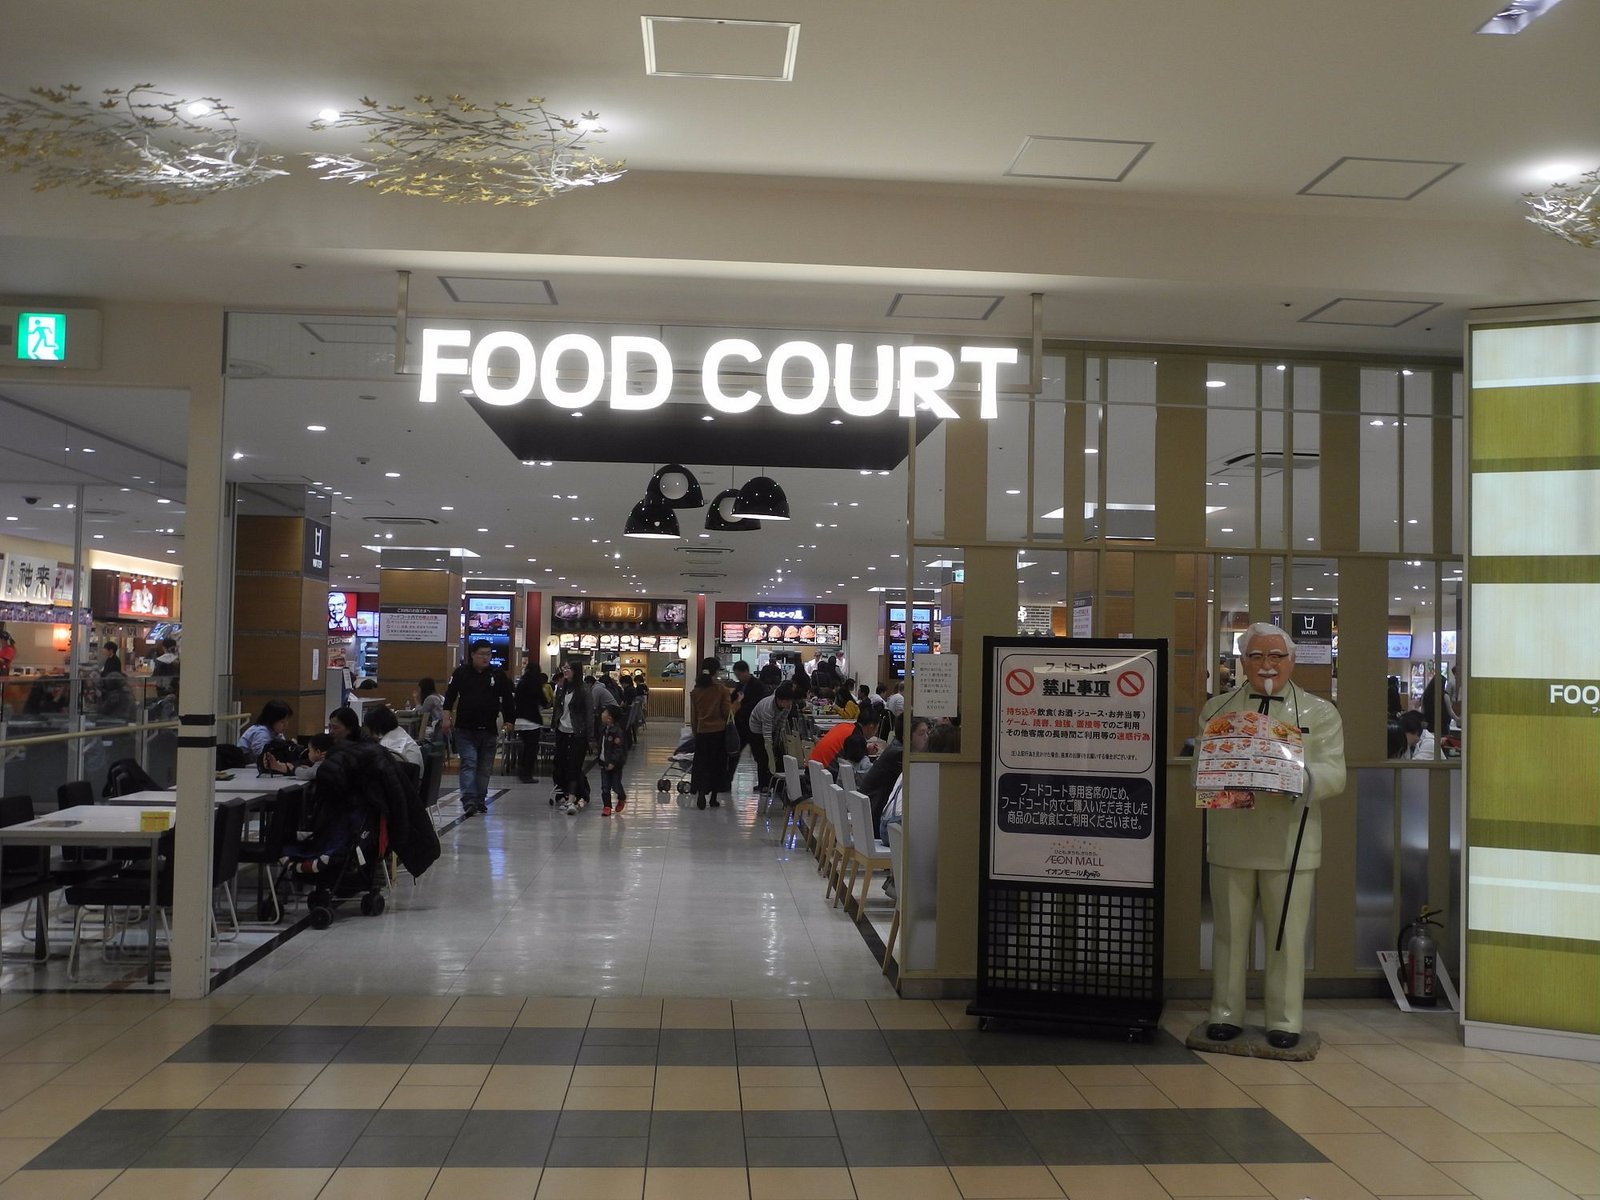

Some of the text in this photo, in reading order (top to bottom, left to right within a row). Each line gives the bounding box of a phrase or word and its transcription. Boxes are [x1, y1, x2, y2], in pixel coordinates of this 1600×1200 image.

[419, 328, 1018, 419] FOOD COURT
[1042, 678, 1111, 696] 禁止事項
[1550, 684, 1600, 705] FOO
[1592, 706, 1600, 714] フ
[1020, 783, 1130, 801] フードコート専用客席のため、
[1001, 796, 1149, 816] フードコート内でご購入いただきました
[1007, 811, 1142, 830] 商品のご飲食にご利用くださいませ。
[1075, 856, 1105, 867] MALL
